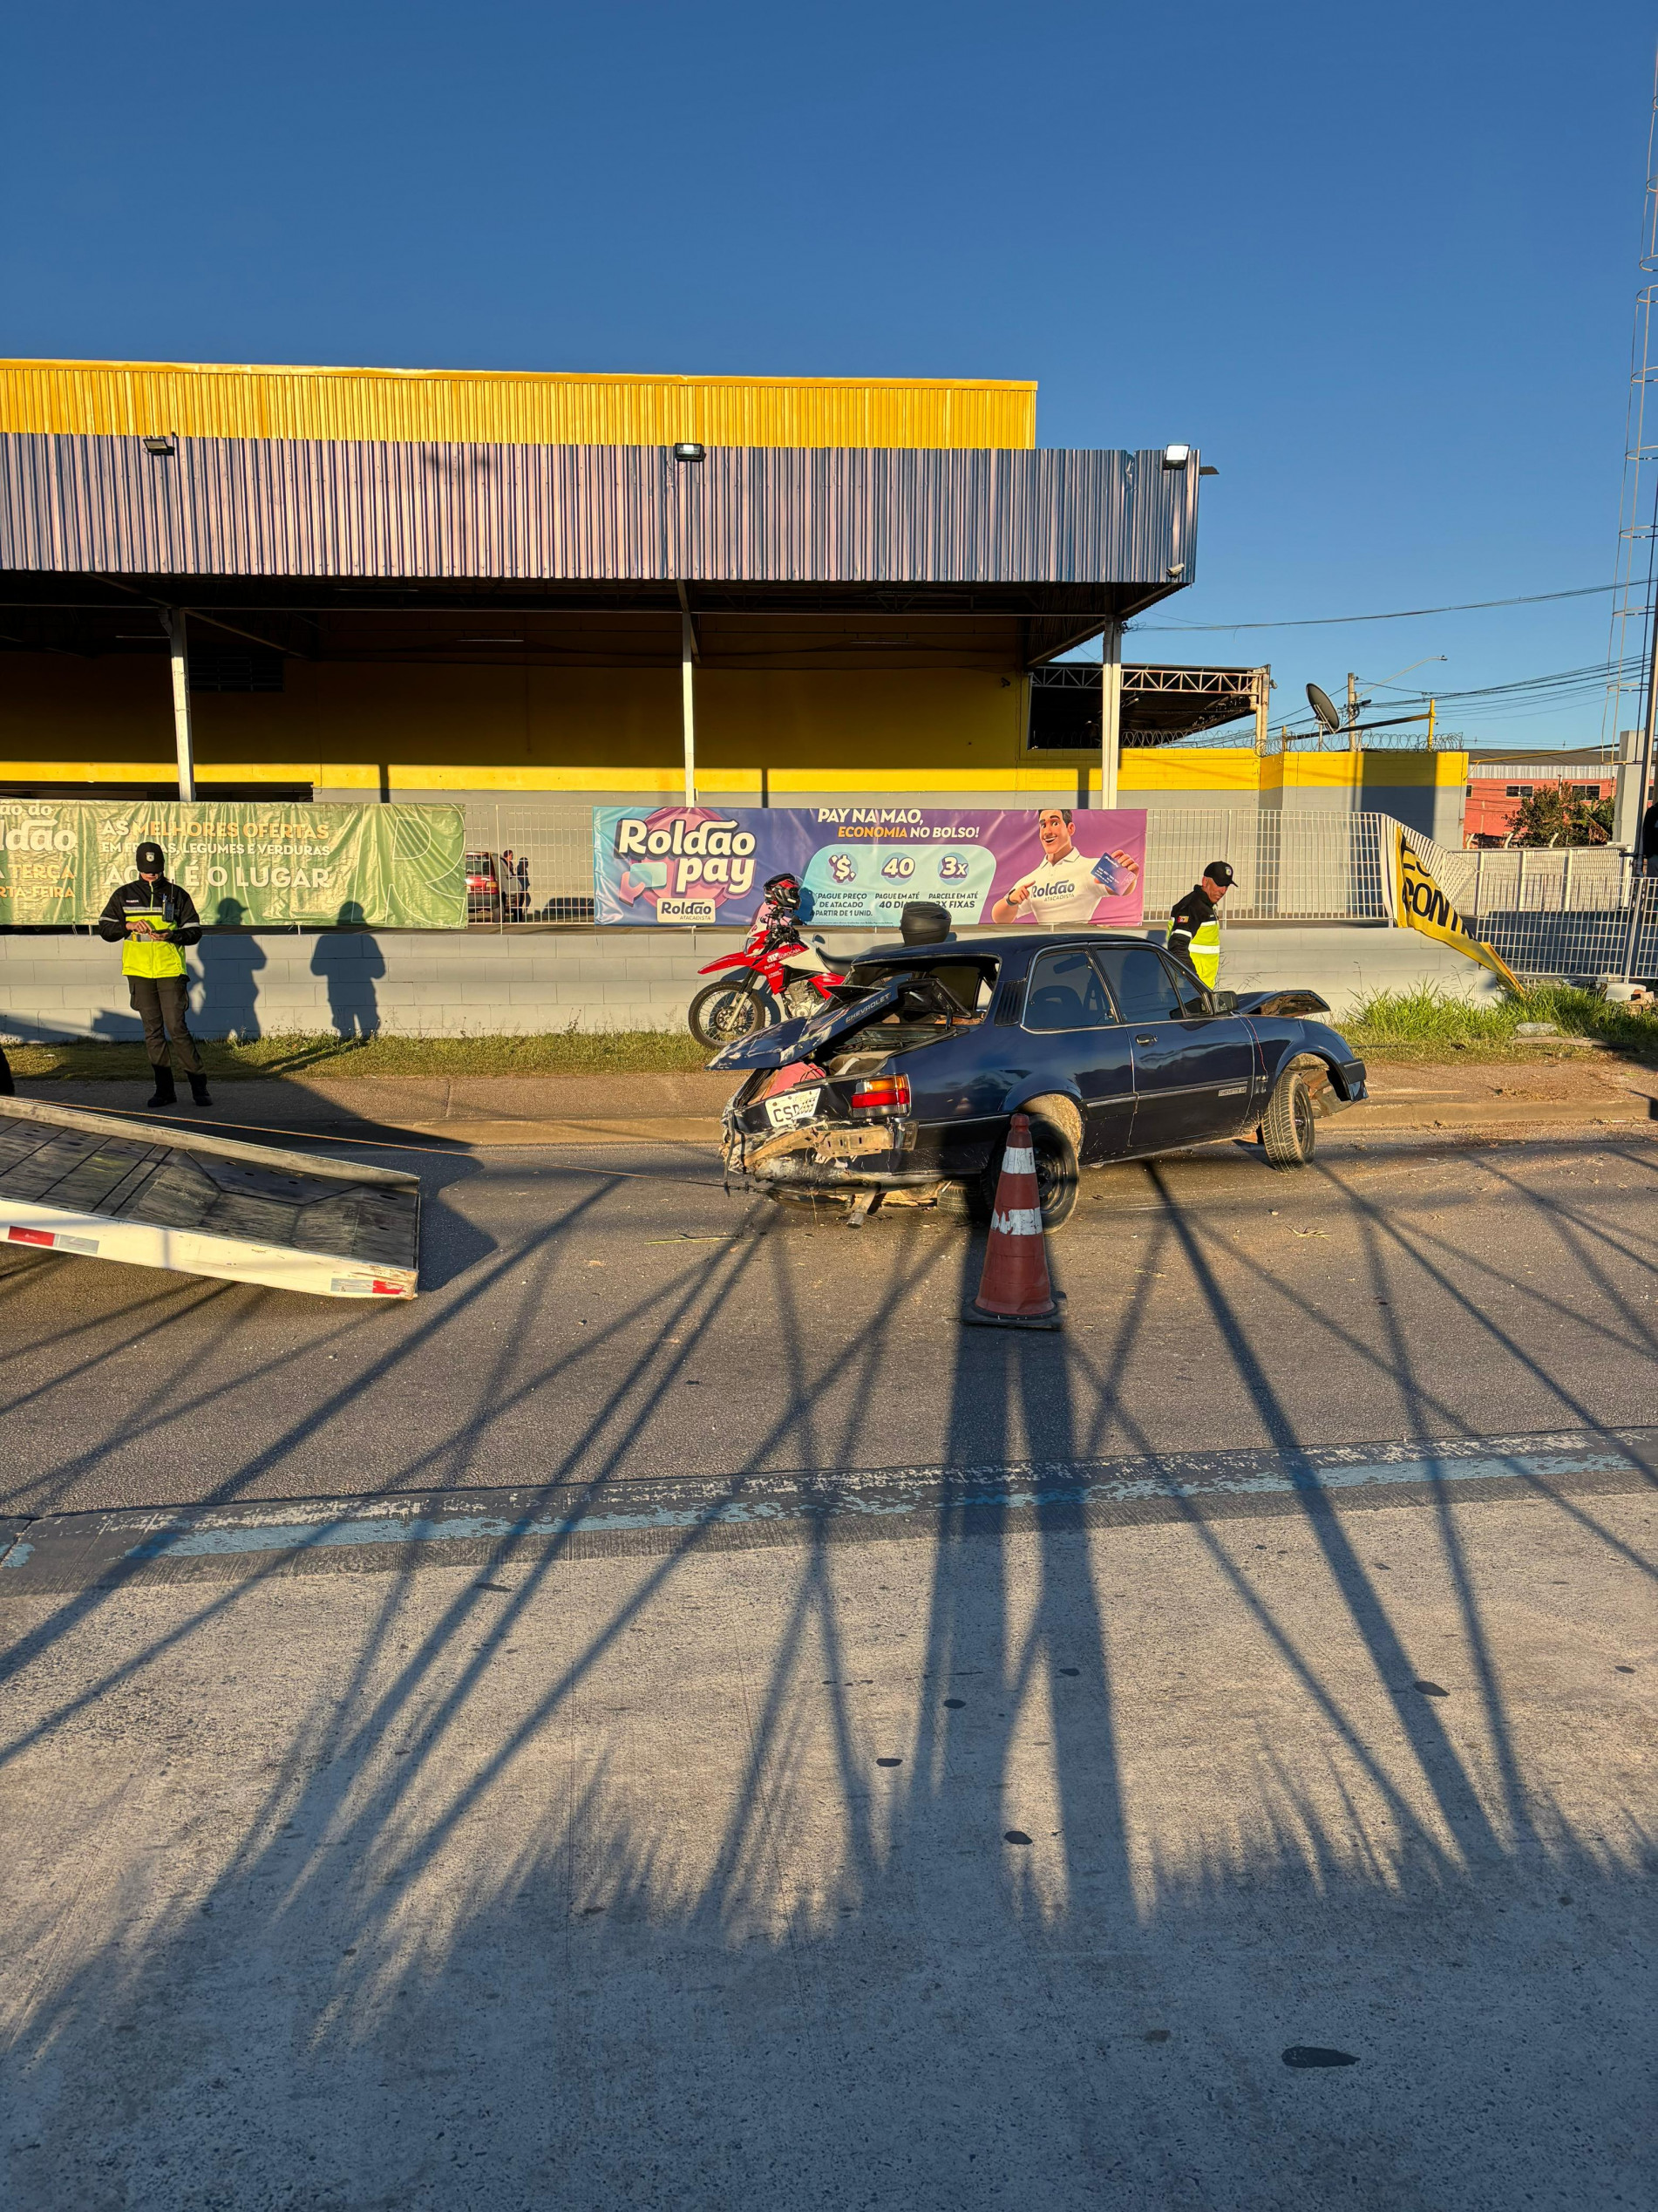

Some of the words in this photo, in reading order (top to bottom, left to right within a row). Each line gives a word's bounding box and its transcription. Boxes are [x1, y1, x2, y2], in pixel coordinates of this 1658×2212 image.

[28, 800, 52, 816] do
[818, 809, 850, 823] PAY
[852, 809, 877, 823] NA
[102, 820, 129, 835] AS
[132, 820, 239, 837] MELHORES
[243, 822, 330, 839] OFERTAS
[838, 826, 907, 838] ECONOMIA
[909, 827, 931, 838] NO
[932, 827, 980, 838] BOLSO!
[102, 842, 122, 853] EM
[183, 843, 244, 854] LEGUMES
[248, 844, 255, 854] E
[257, 844, 330, 855] VERDURAS
[8, 864, 75, 883] TERÇA
[185, 860, 200, 887] É
[207, 866, 228, 887] O
[235, 868, 330, 888] LUGAR
[882, 857, 915, 877] 40
[673, 857, 757, 895] pay
[842, 893, 867, 902] PREÇO
[908, 891, 921, 900] ATÉ
[967, 891, 978, 900] ATÉ
[1043, 894, 1075, 902] ATACADISTA
